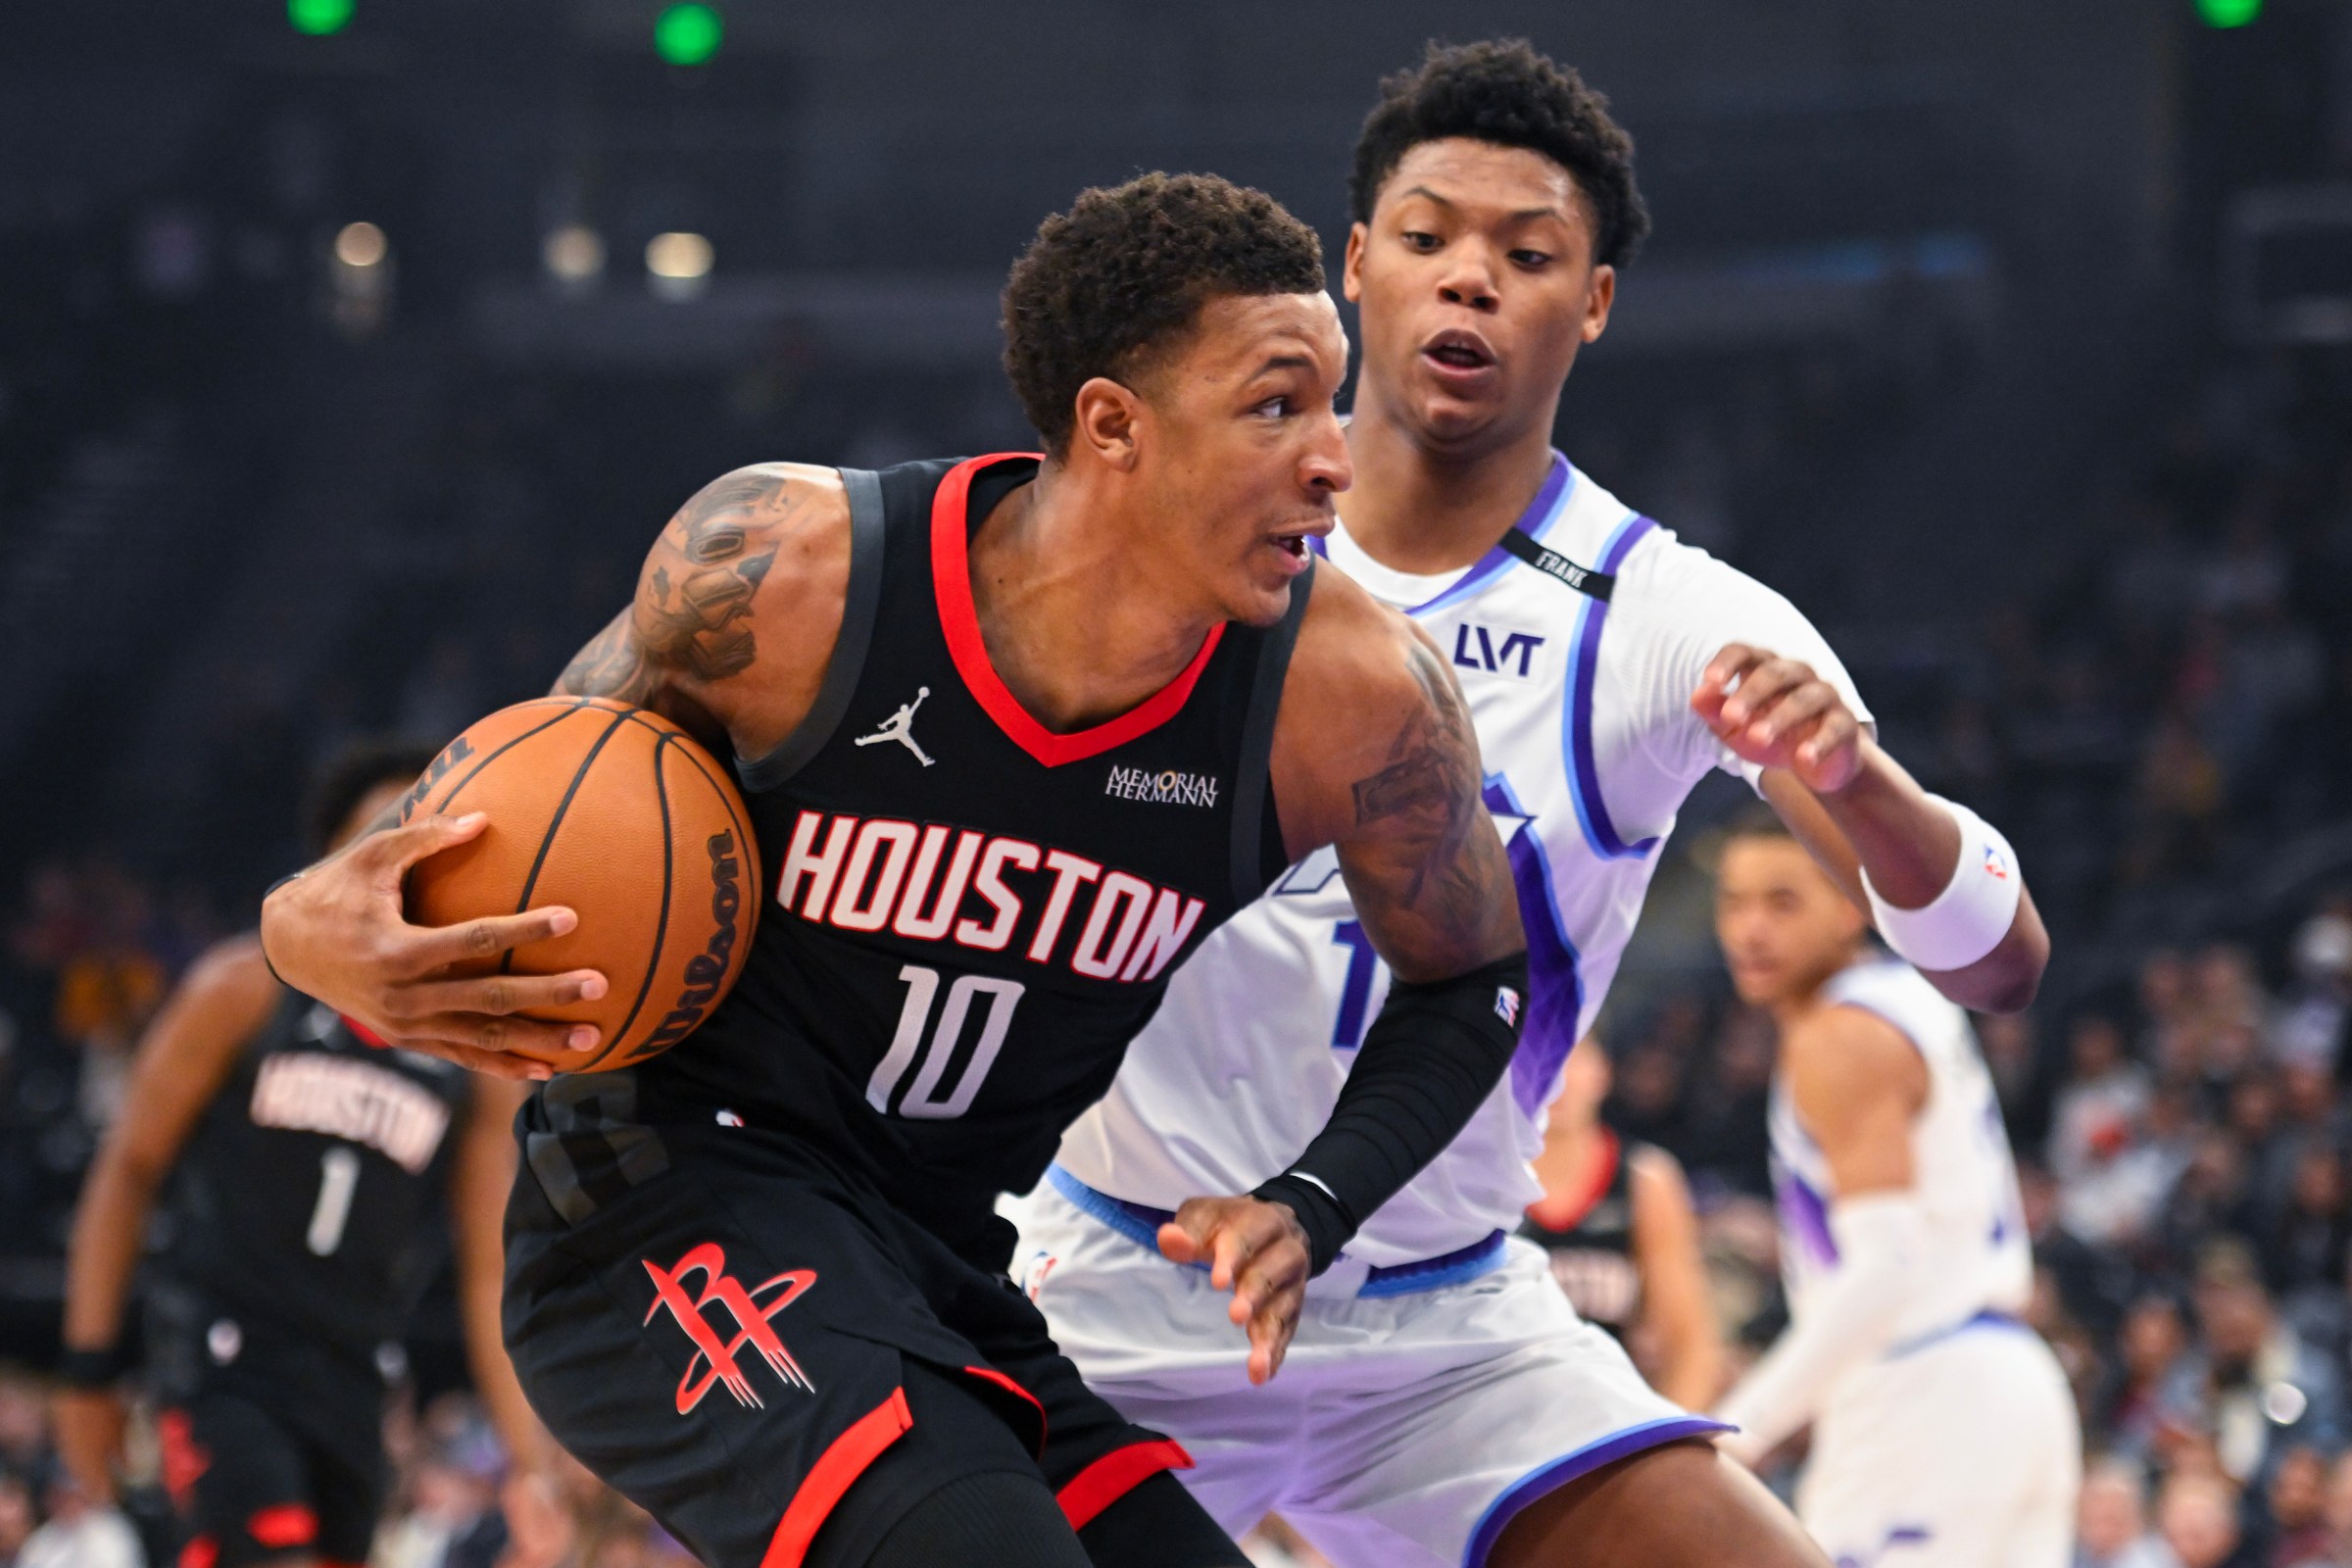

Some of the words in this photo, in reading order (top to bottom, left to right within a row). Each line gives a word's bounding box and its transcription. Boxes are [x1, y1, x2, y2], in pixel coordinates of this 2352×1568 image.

[1535, 550, 1589, 588] FRANK
[1453, 622, 1545, 677] LVT
[1104, 777, 1217, 808] HERMANN
[1108, 764, 1219, 796] MEMORIAL
[775, 809, 1206, 983] HOUSTON
[620, 828, 740, 1060] Wilson
[864, 963, 1027, 1120] 10
[306, 1145, 360, 1257] 1
